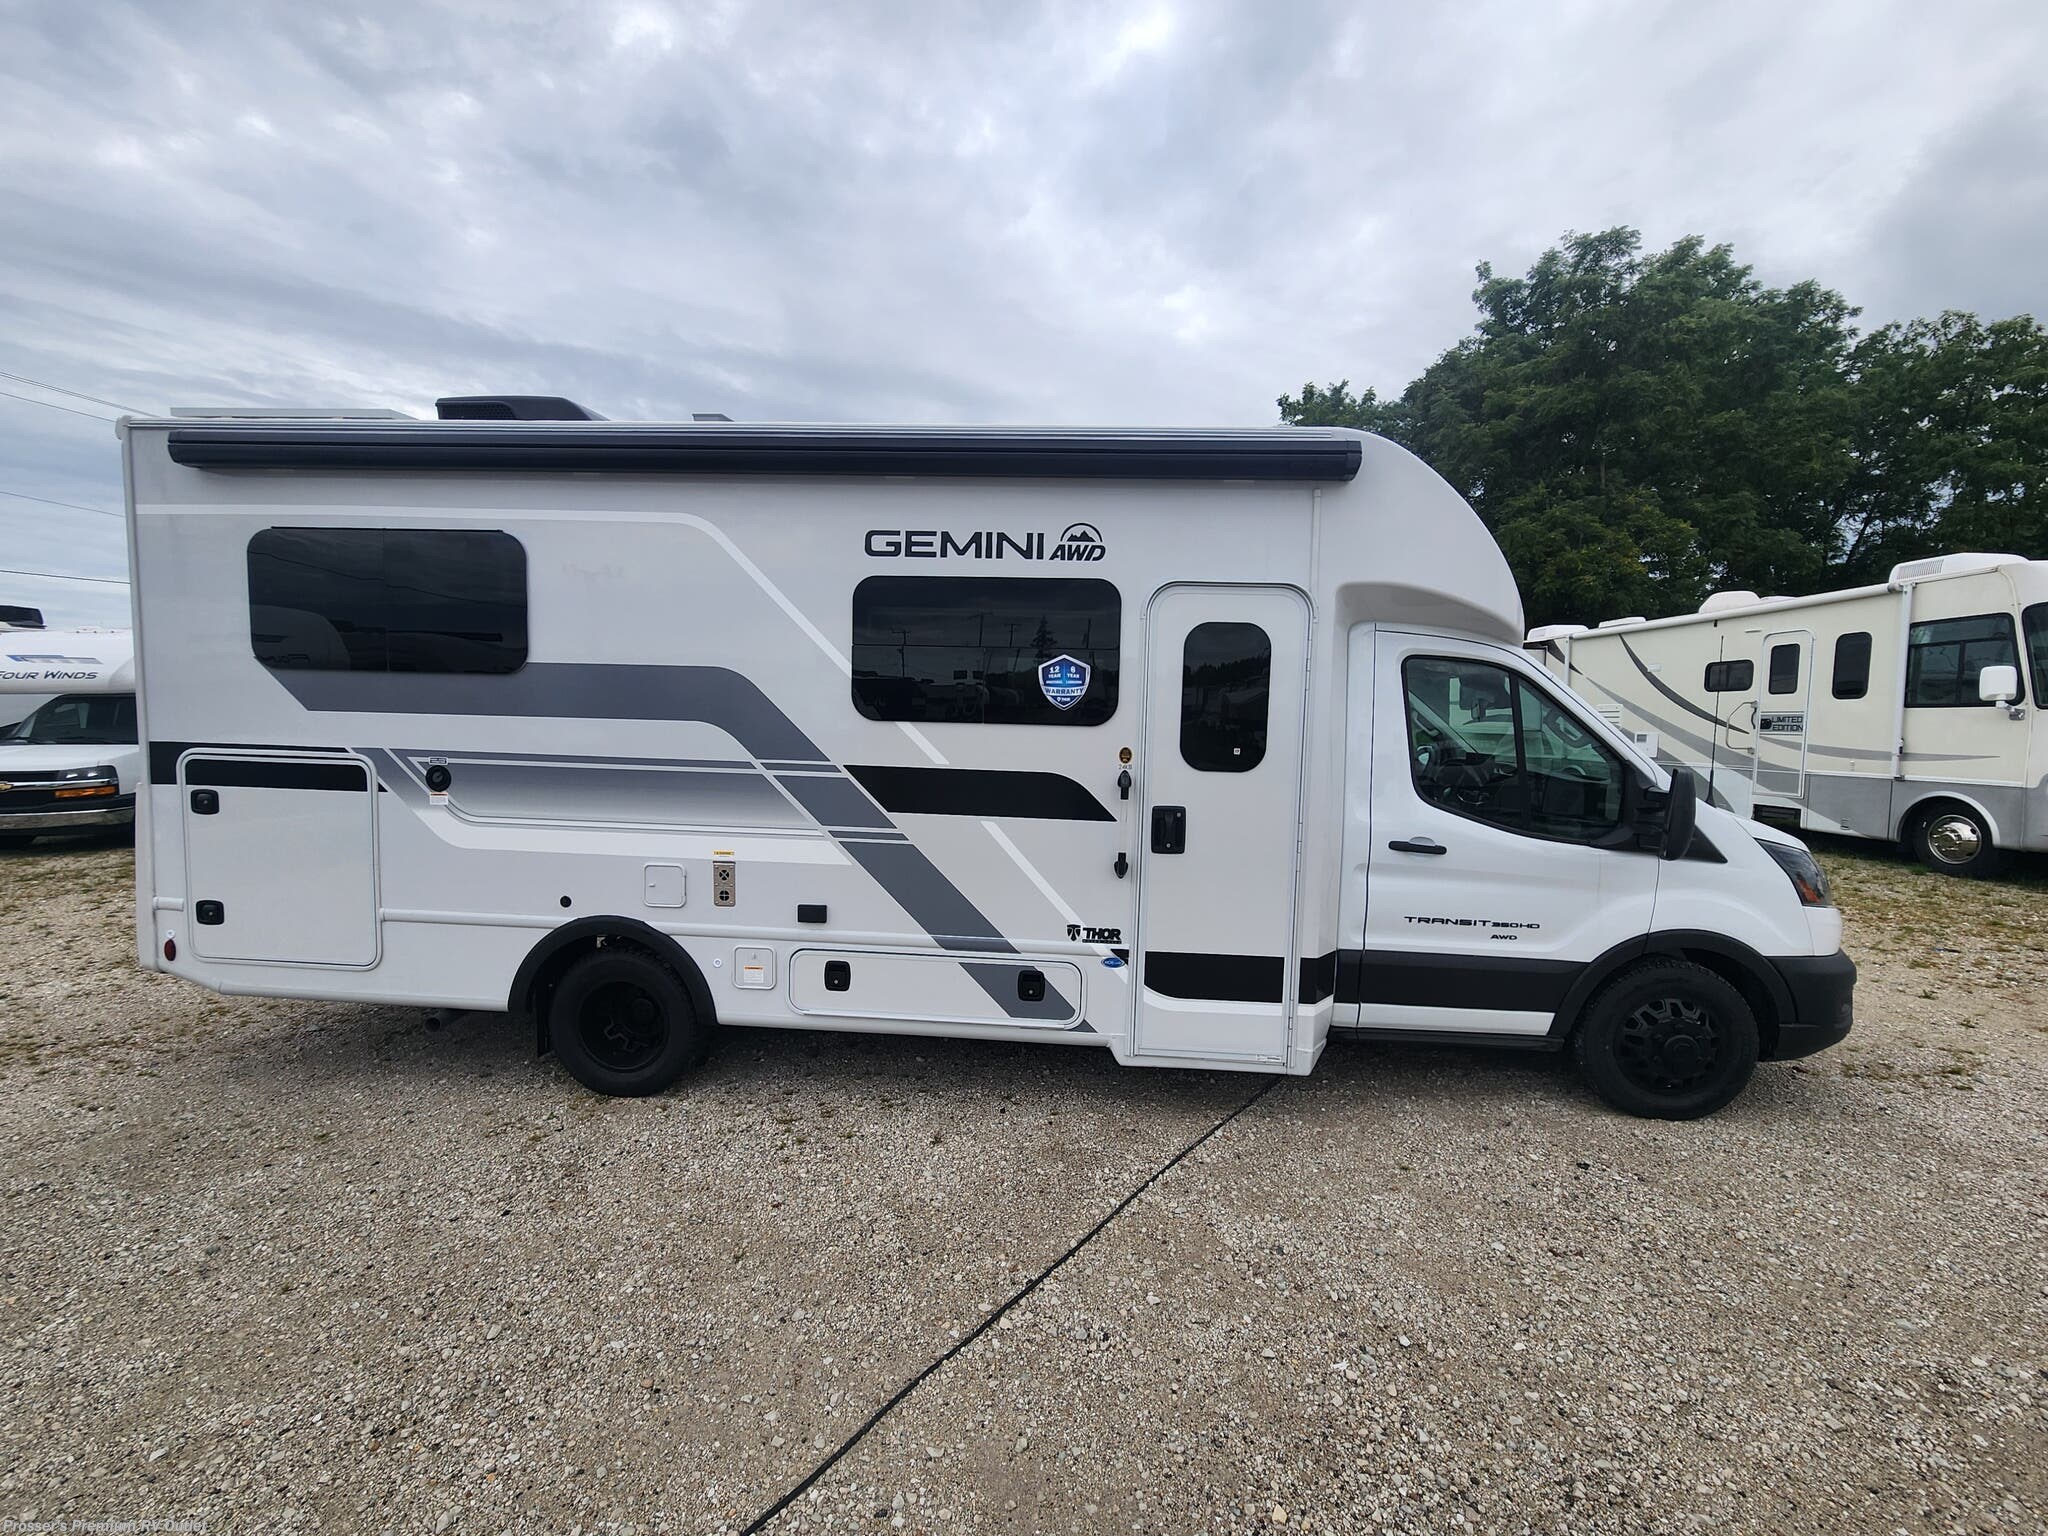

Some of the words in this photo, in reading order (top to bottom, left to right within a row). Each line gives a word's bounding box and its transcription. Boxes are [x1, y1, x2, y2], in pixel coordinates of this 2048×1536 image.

[864, 530, 1045, 559] GEMINI
[1049, 544, 1106, 562] AWD
[44, 670, 98, 679] WINDS
[1404, 916, 1491, 927] TRANSIT
[1083, 927, 1122, 940] THOR
